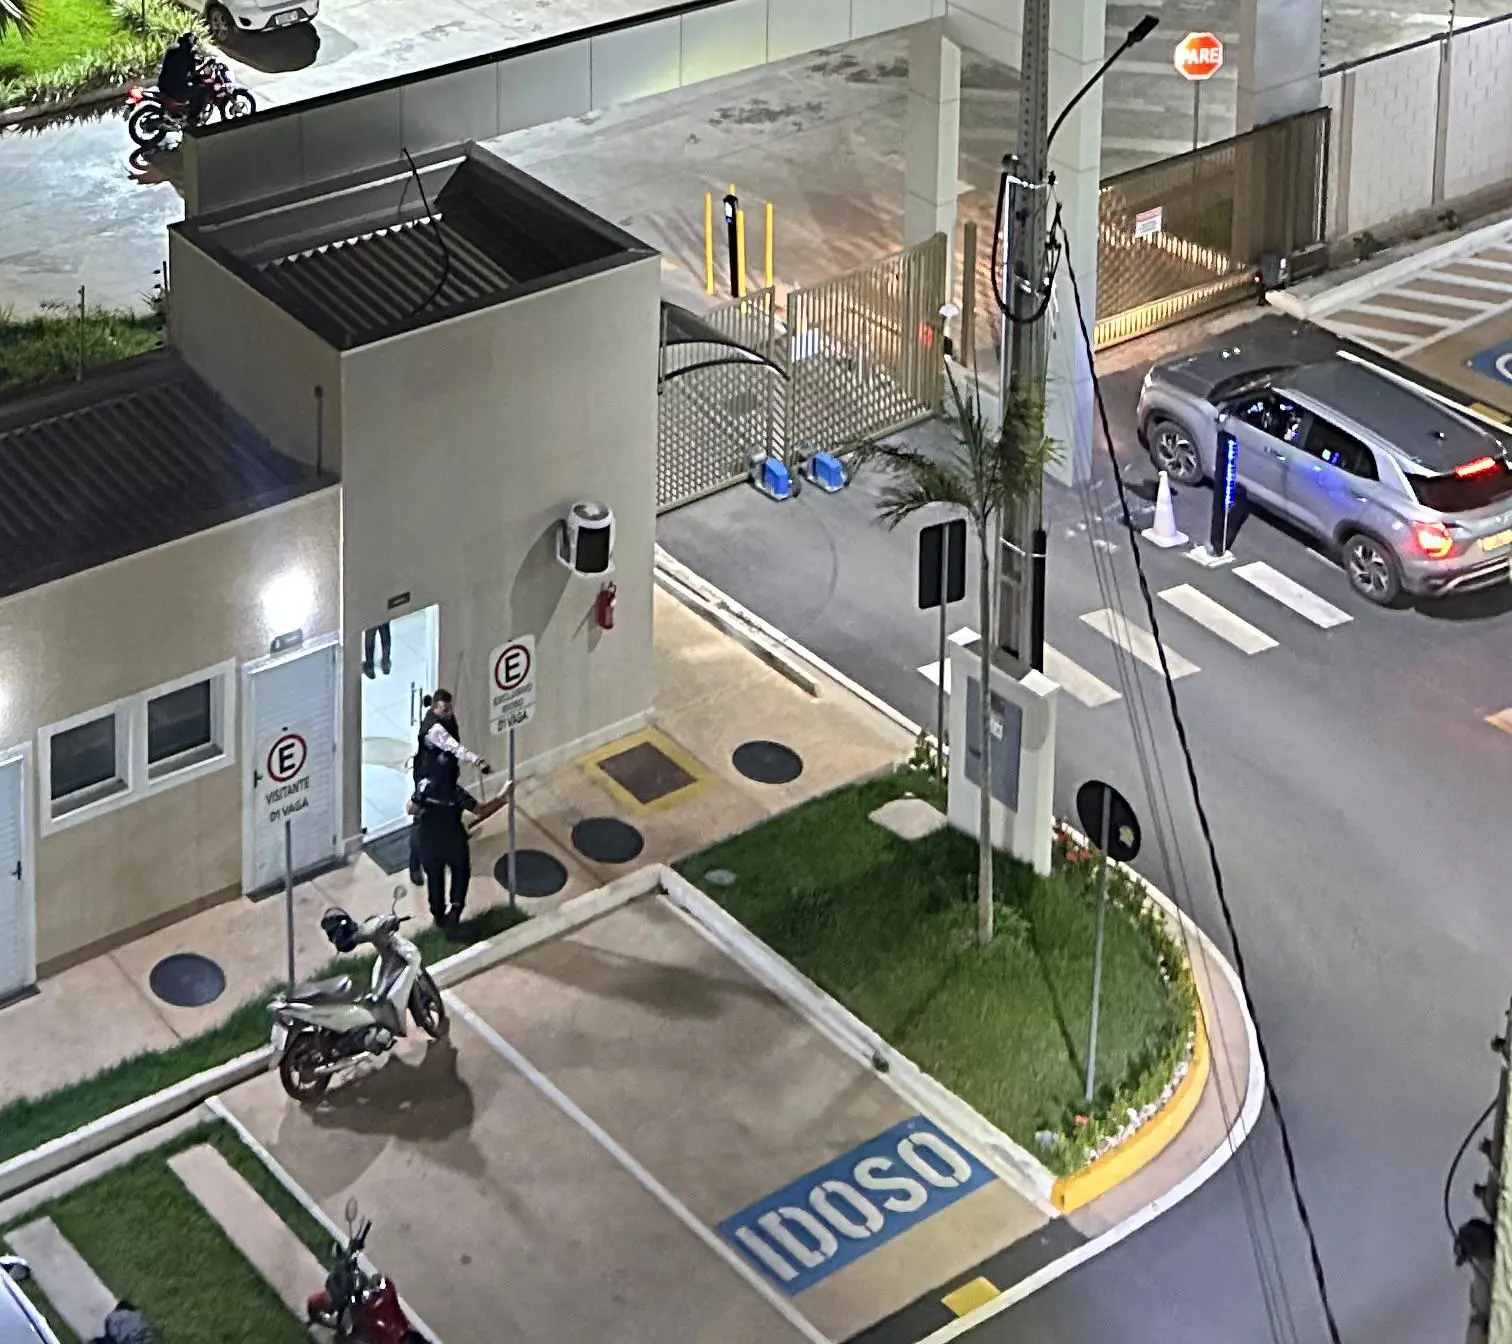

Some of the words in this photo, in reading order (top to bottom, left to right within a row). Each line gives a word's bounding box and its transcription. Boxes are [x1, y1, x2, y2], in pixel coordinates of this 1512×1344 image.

[504, 652, 521, 683] E
[279, 742, 296, 775] E
[265, 776, 310, 806] VISITANTE
[282, 797, 309, 817] VAGA
[735, 1131, 972, 1281] IDOSO
